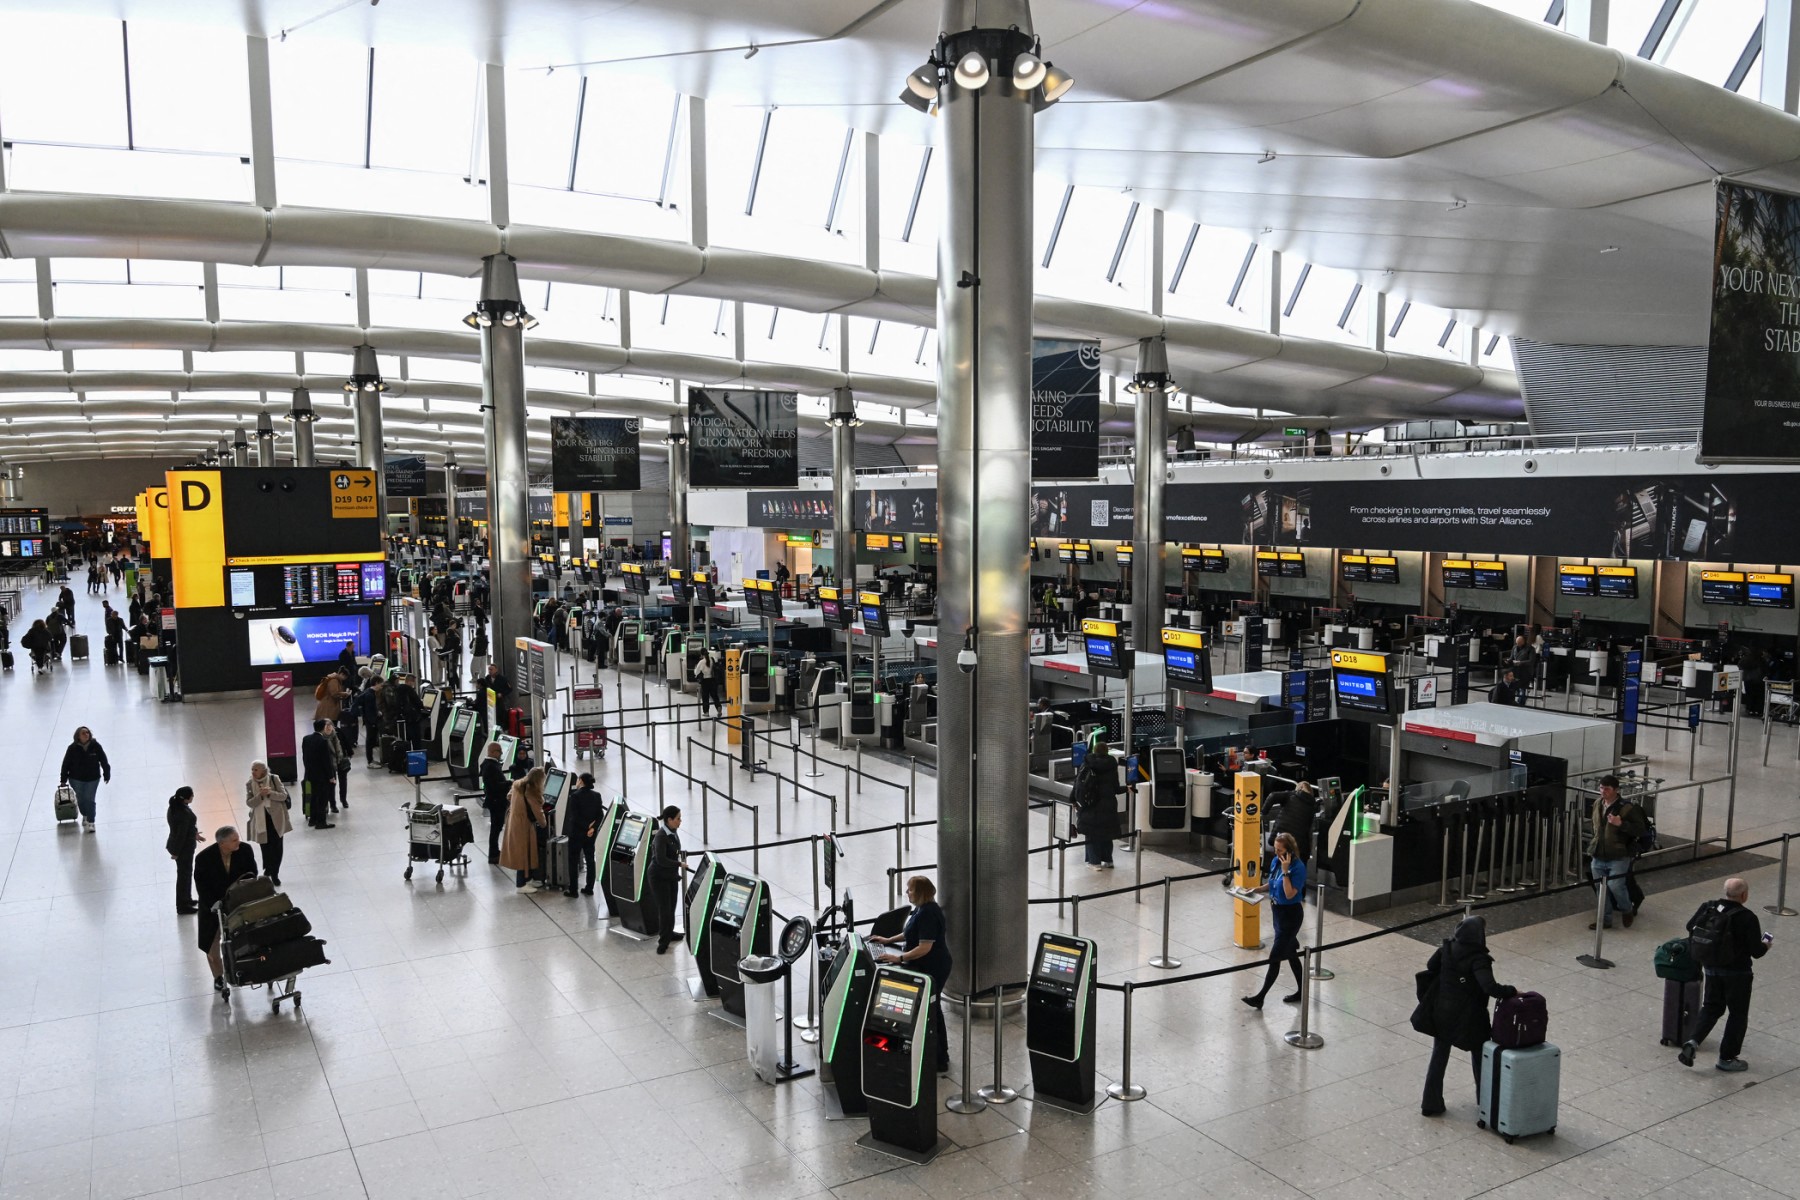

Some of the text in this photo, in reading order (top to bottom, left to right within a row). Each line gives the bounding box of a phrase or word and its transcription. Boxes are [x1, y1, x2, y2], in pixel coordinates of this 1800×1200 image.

[1721, 265, 1763, 293] YOUR
[1083, 346, 1100, 360] SG
[784, 395, 797, 405] SG
[1768, 400, 1790, 408] BUSINESS
[705, 428, 796, 439] INNOVATION NEEDS
[556, 439, 577, 447] YOUR
[698, 438, 762, 448] CLOCKWORK
[181, 481, 210, 511] D
[1350, 506, 1369, 514] From
[1370, 506, 1403, 516] checking
[1422, 507, 1451, 516] earning
[1452, 507, 1475, 515] miles,
[1478, 507, 1500, 515] travel
[1502, 507, 1551, 517] seamlessly
[1430, 516, 1460, 525] airports
[1480, 517, 1497, 525] Star
[1499, 517, 1533, 525] Alliance.
[1343, 655, 1357, 663] D18
